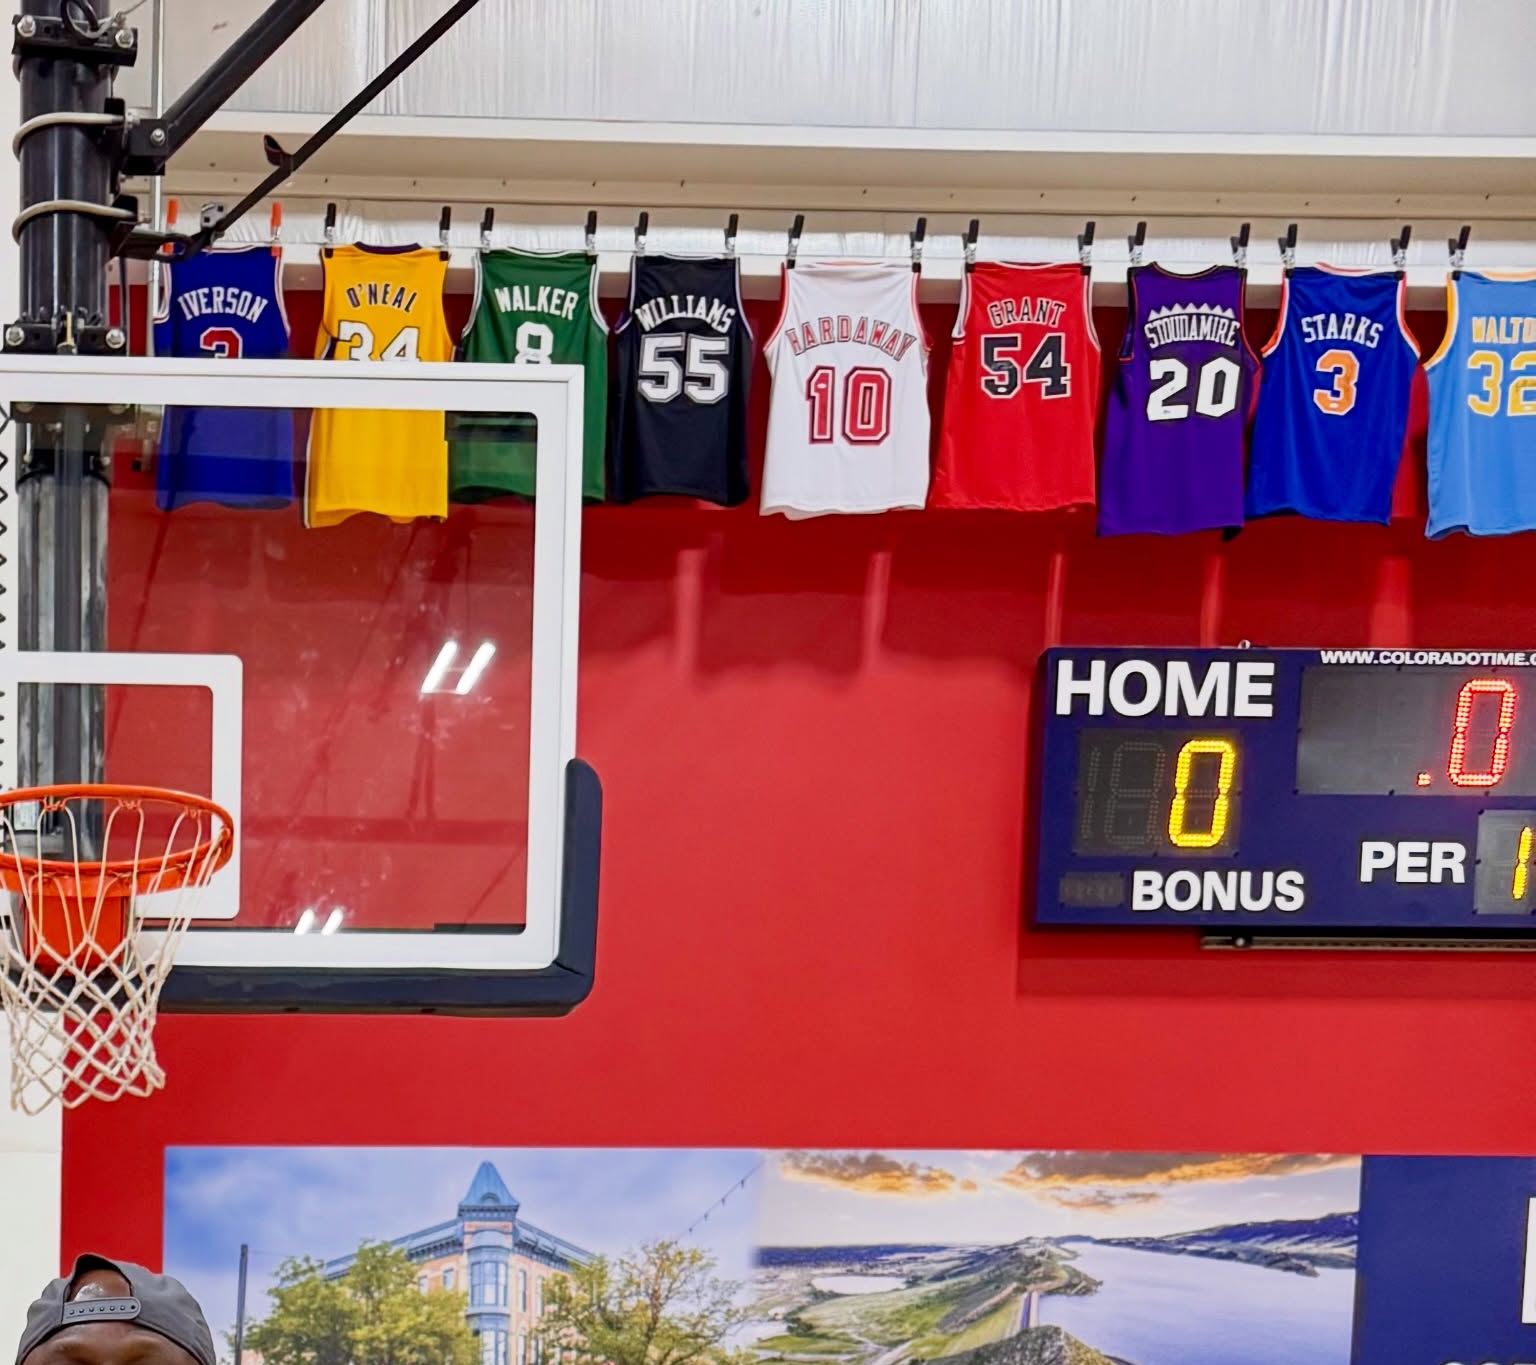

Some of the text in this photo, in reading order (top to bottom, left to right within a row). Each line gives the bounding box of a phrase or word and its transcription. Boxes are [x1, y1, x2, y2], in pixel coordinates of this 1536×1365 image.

[176, 286, 268, 323] IVERSON
[345, 283, 419, 313] O'NEAL
[493, 286, 579, 320] WALKER
[633, 295, 737, 335] WILLIAMS
[987, 296, 1066, 329] GRANT
[337, 319, 422, 362] 34
[784, 314, 917, 362] HARDAWAY
[1143, 318, 1241, 350] STOUDAMIRE
[1300, 312, 1384, 349] STARKS
[637, 333, 730, 405] 55
[979, 332, 1072, 400] 54
[1313, 349, 1361, 417] 3
[1467, 350, 1536, 417] 32
[805, 365, 892, 446] 10
[1145, 356, 1241, 423] 20
[1056, 659, 1276, 718] HOME
[1168, 739, 1237, 848] 0
[1360, 841, 1467, 884] PER
[1131, 870, 1305, 912] BONUS
